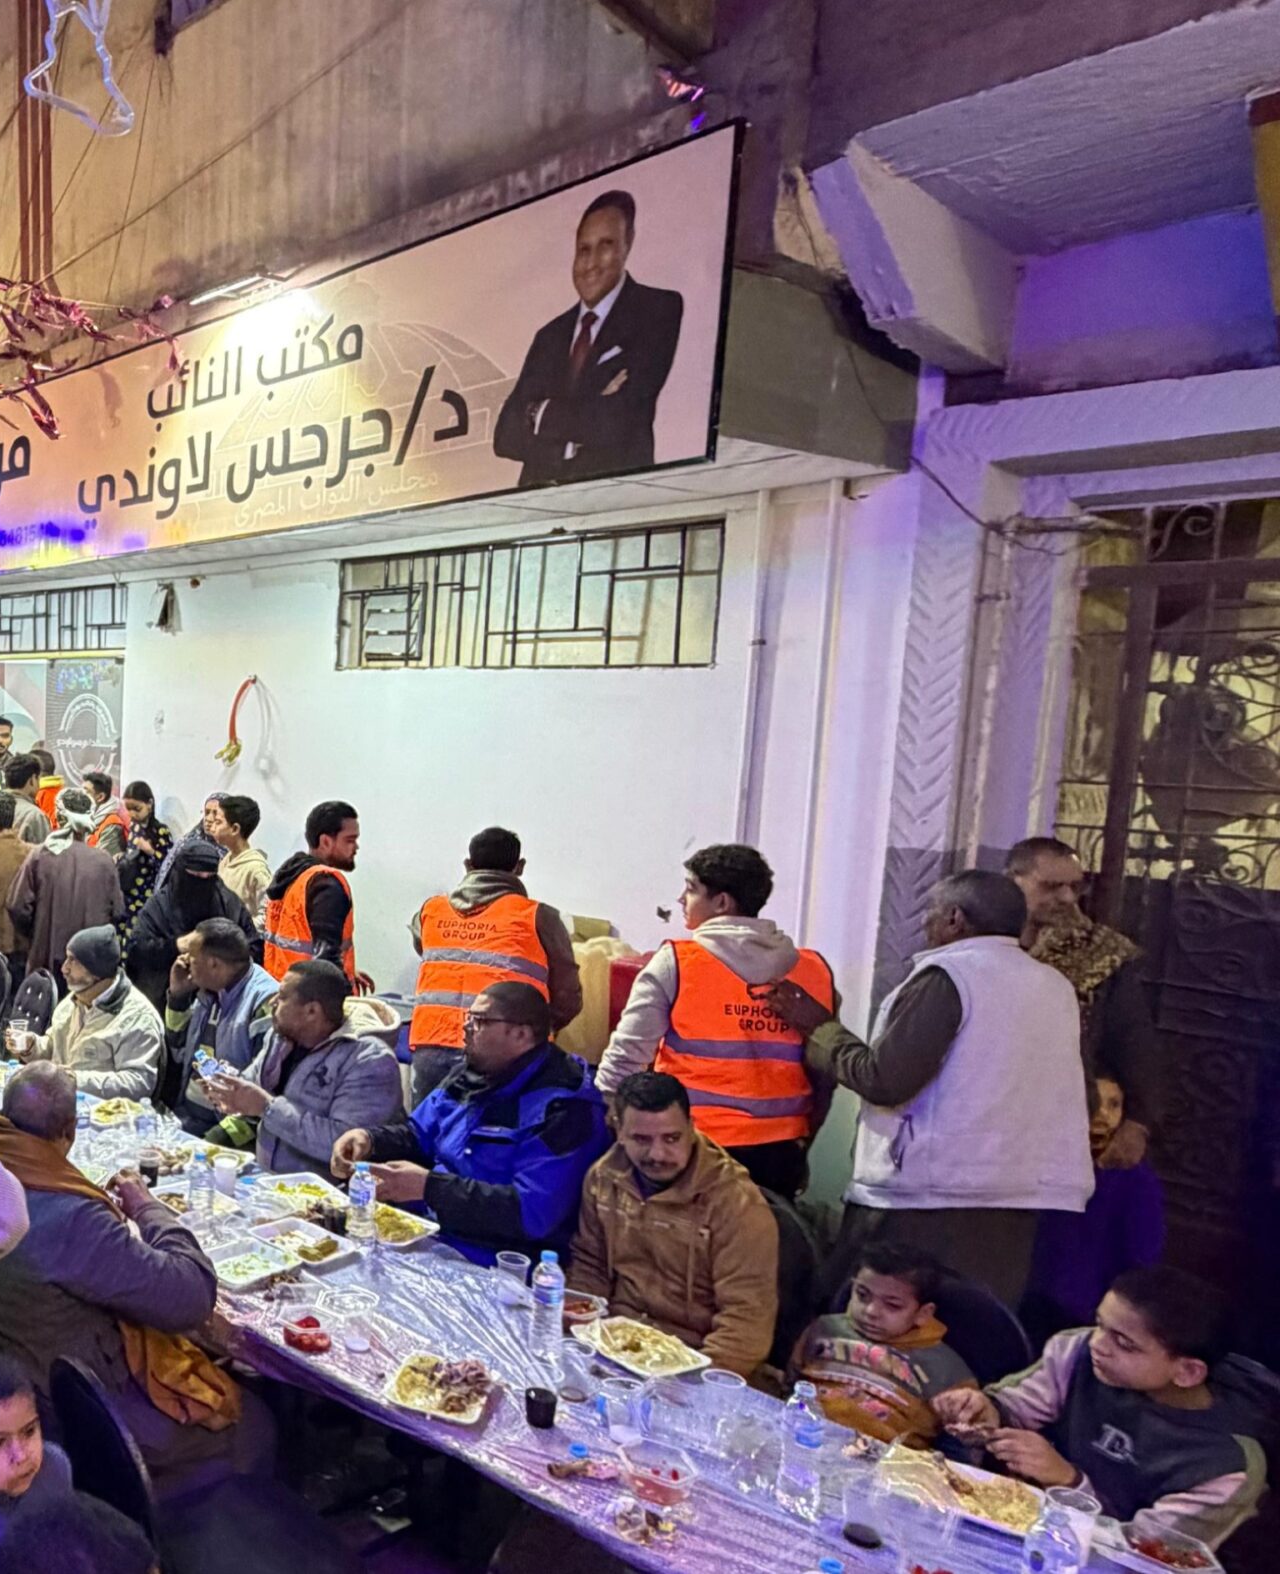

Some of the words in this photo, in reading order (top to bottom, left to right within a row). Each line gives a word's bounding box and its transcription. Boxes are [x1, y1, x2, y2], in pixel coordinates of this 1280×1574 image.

[257, 316, 363, 400] مكتب
[147, 344, 243, 432] النائب
[78, 431, 211, 532] لاوندي
[437, 919, 497, 932] EUPHORIA
[442, 930, 486, 941] GROUP
[724, 1004, 784, 1020] EUPHO
[738, 1018, 790, 1034] GROUP
